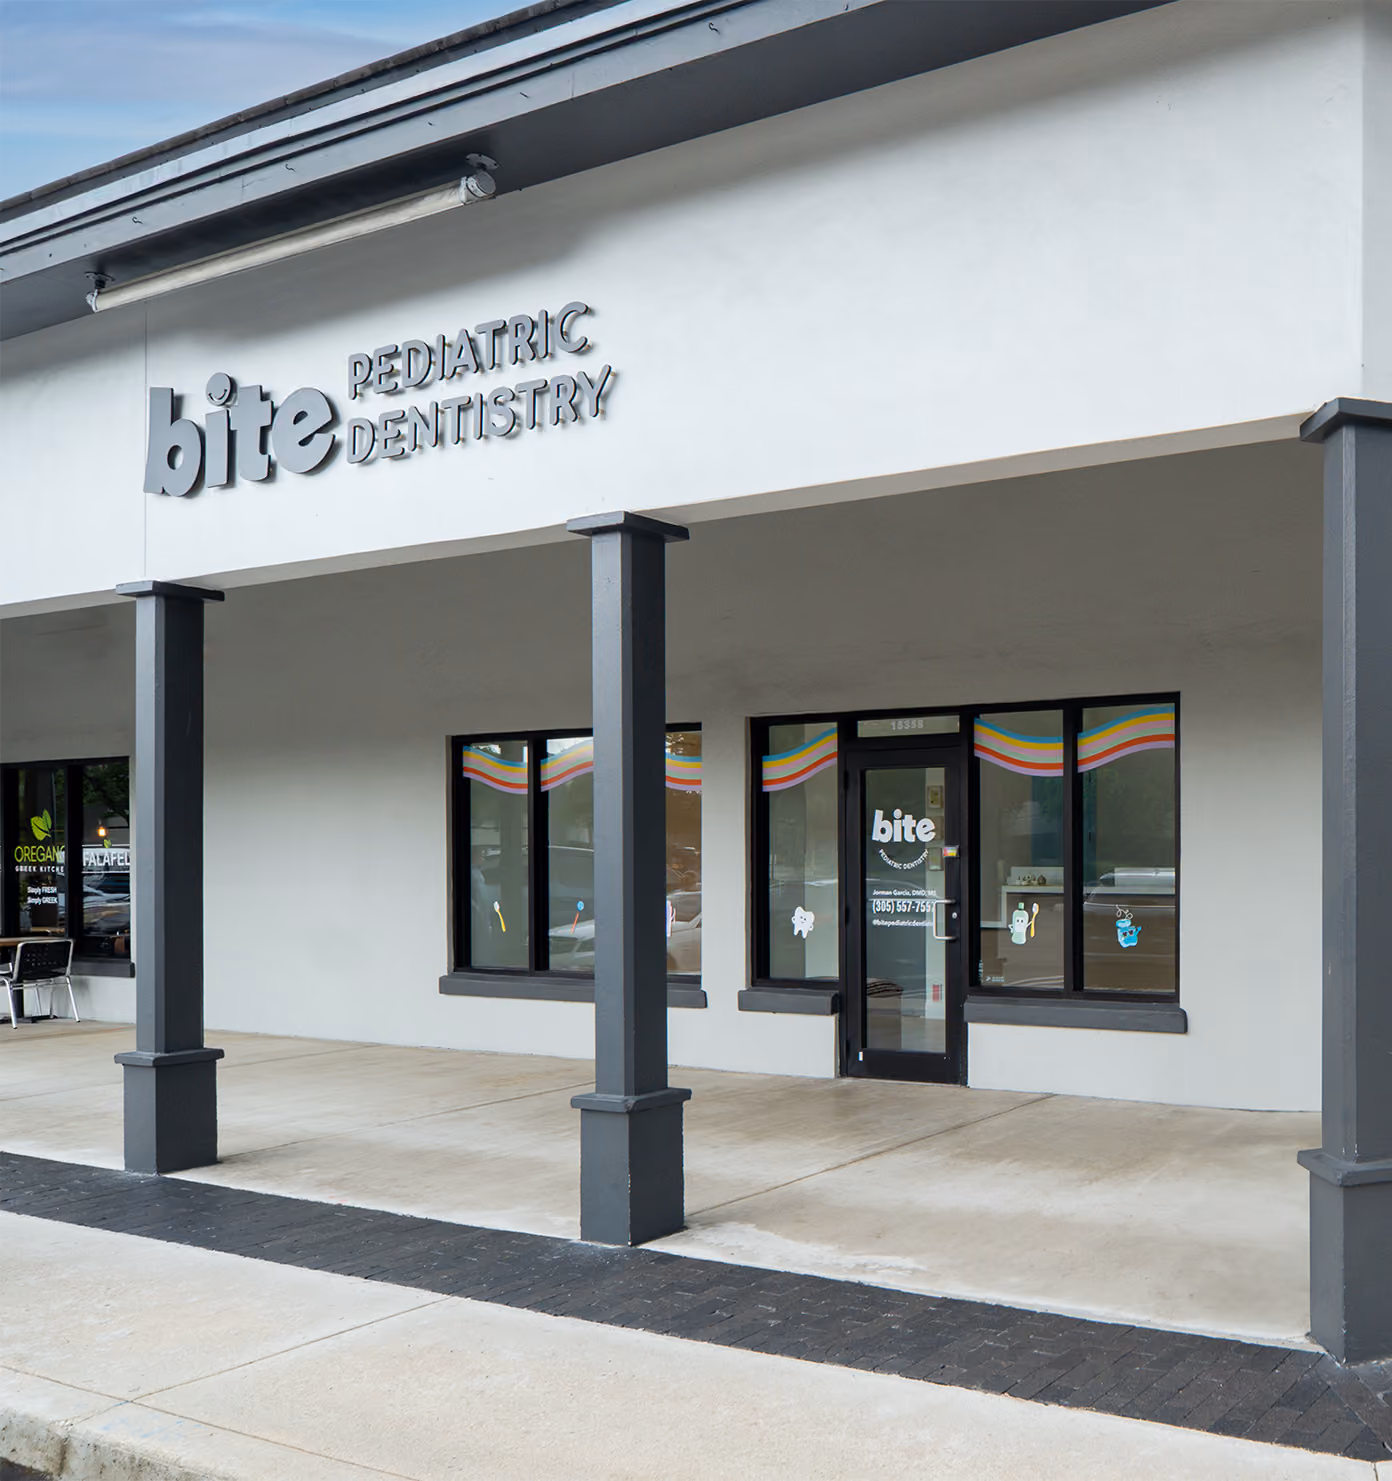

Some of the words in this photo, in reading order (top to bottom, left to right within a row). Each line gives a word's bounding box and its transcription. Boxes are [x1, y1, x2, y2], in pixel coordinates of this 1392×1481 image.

[347, 301, 597, 402] PEDIATRIC
[143, 371, 337, 498] bite
[346, 364, 616, 465] DENTISTRY
[871, 808, 936, 843] bite
[872, 899, 895, 914] (305)
